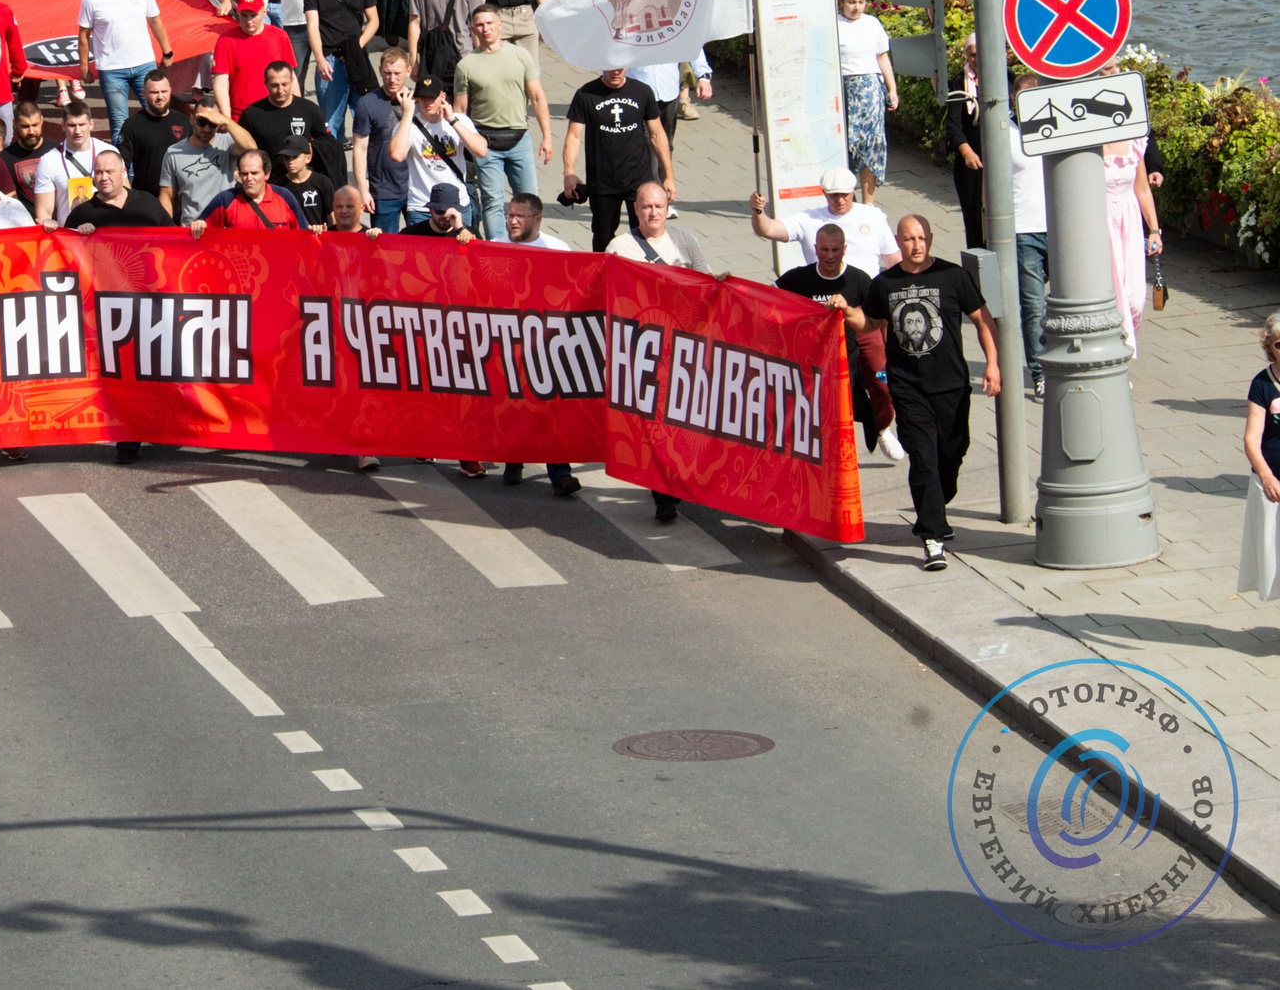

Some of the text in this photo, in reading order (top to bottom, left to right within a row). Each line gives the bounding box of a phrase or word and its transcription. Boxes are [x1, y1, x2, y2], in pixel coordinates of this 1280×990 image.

[100, 297, 251, 379] РИМ!
[302, 301, 333, 383] А
[610, 319, 662, 415] НЕ
[666, 334, 823, 462] БЫВАТЬ!
